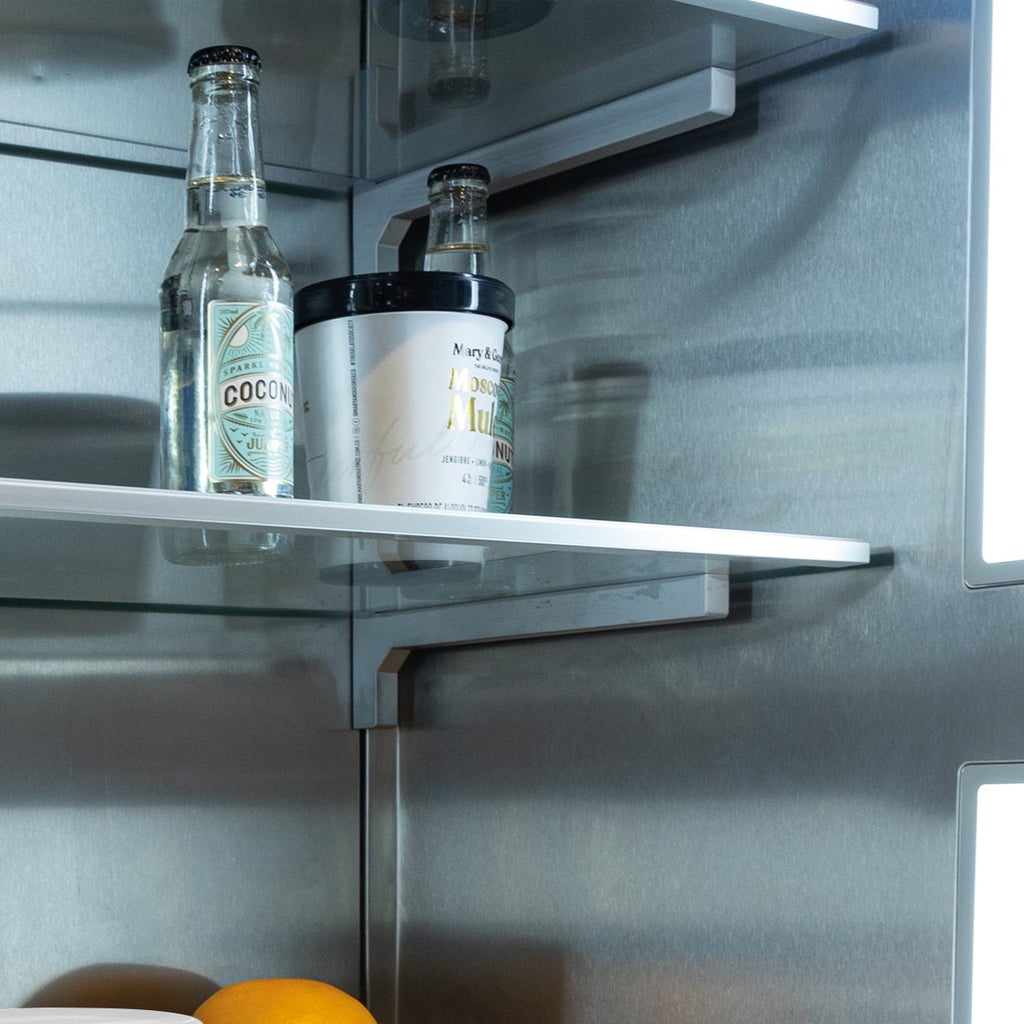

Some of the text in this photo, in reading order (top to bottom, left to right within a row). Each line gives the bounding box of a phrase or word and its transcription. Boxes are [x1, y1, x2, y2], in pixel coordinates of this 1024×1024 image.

[453, 343, 483, 361] Mary
[224, 380, 293, 408] COCONU
[448, 367, 497, 397] Mosco
[447, 394, 494, 436] Mul
